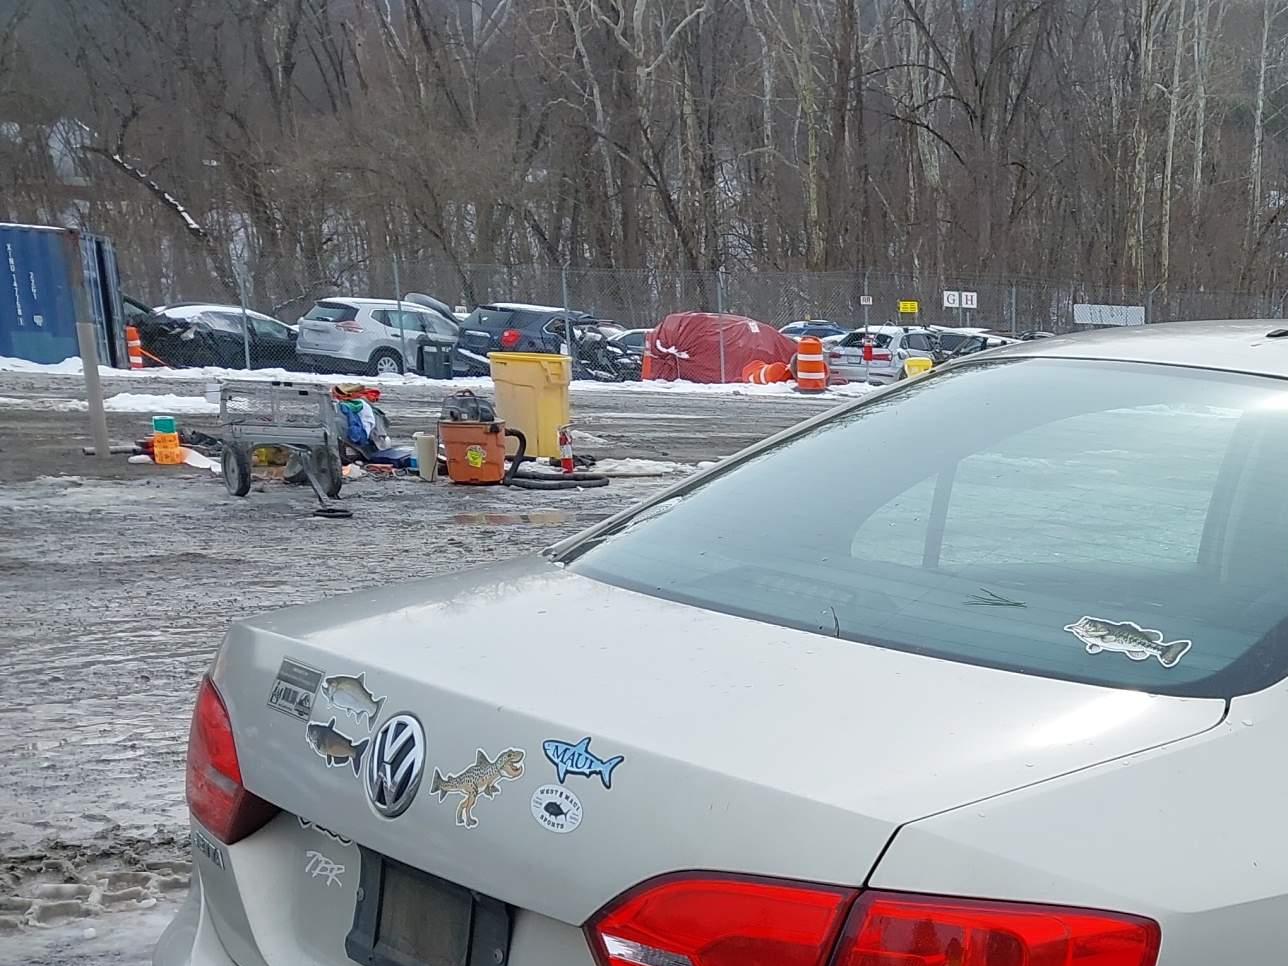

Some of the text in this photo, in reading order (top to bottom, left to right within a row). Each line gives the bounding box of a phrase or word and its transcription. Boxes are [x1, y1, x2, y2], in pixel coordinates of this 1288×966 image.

[946, 293, 956, 305] G
[965, 294, 975, 306] H
[552, 745, 595, 769] MAUI
